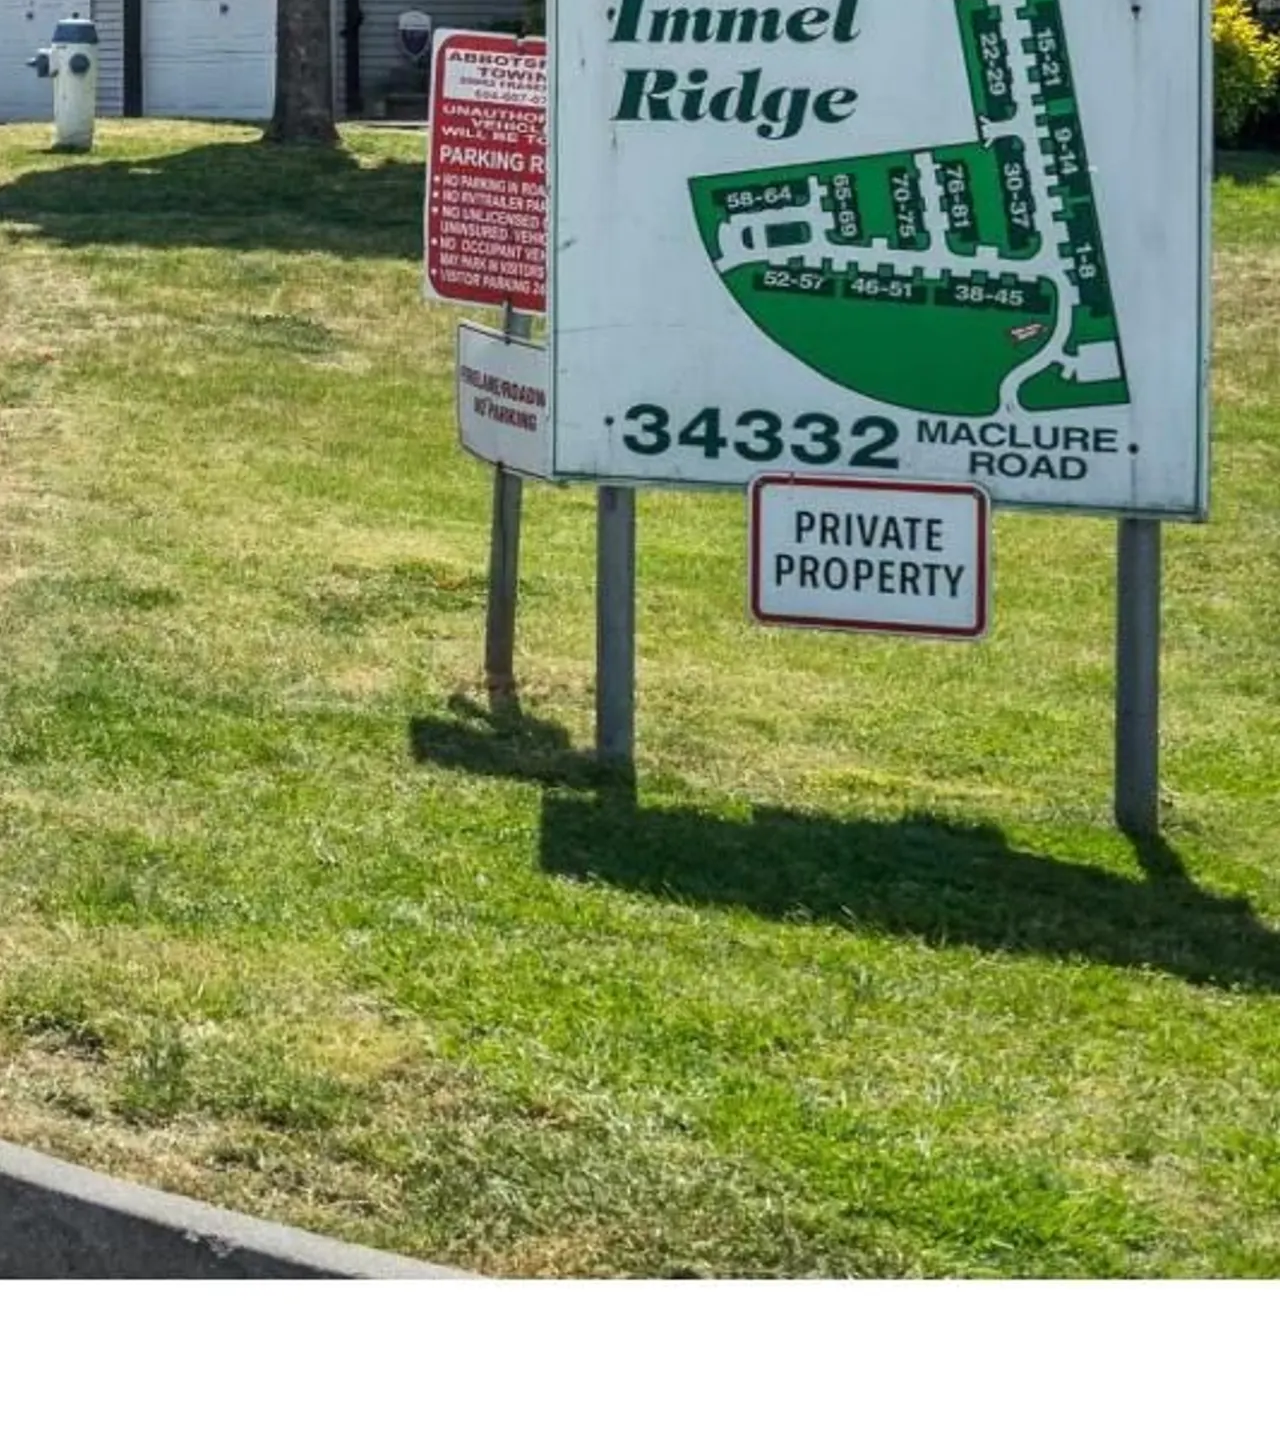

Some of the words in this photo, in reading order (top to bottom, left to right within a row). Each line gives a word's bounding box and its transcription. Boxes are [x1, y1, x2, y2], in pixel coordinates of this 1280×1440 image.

[980, 33, 1007, 96] 22-29
[1037, 27, 1062, 87] 15-21
[609, 67, 859, 140] Ridge
[441, 126, 486, 141] WILL
[493, 132, 518, 144] BE
[1054, 127, 1078, 175] 9-14
[440, 144, 525, 172] PARKING
[442, 173, 459, 188] NO
[461, 175, 506, 192] PARKING
[442, 189, 459, 203] NO
[727, 186, 791, 208] 58-64
[946, 164, 972, 228] 76-81
[1004, 162, 1030, 230] 30-37
[442, 205, 460, 219] NO
[833, 174, 858, 237] 65-69
[892, 174, 916, 237] 70-75
[440, 236, 456, 250] NO
[1075, 243, 1097, 279] 1-8
[763, 270, 825, 290] 52-57
[851, 279, 912, 297] 46-51
[955, 285, 1025, 306] 38-45
[623, 403, 900, 470] 34332
[916, 419, 1119, 453] MACLURE
[968, 451, 1088, 481] ROAD
[795, 510, 943, 552] PRIVATE
[774, 553, 965, 598] PROPERTY
